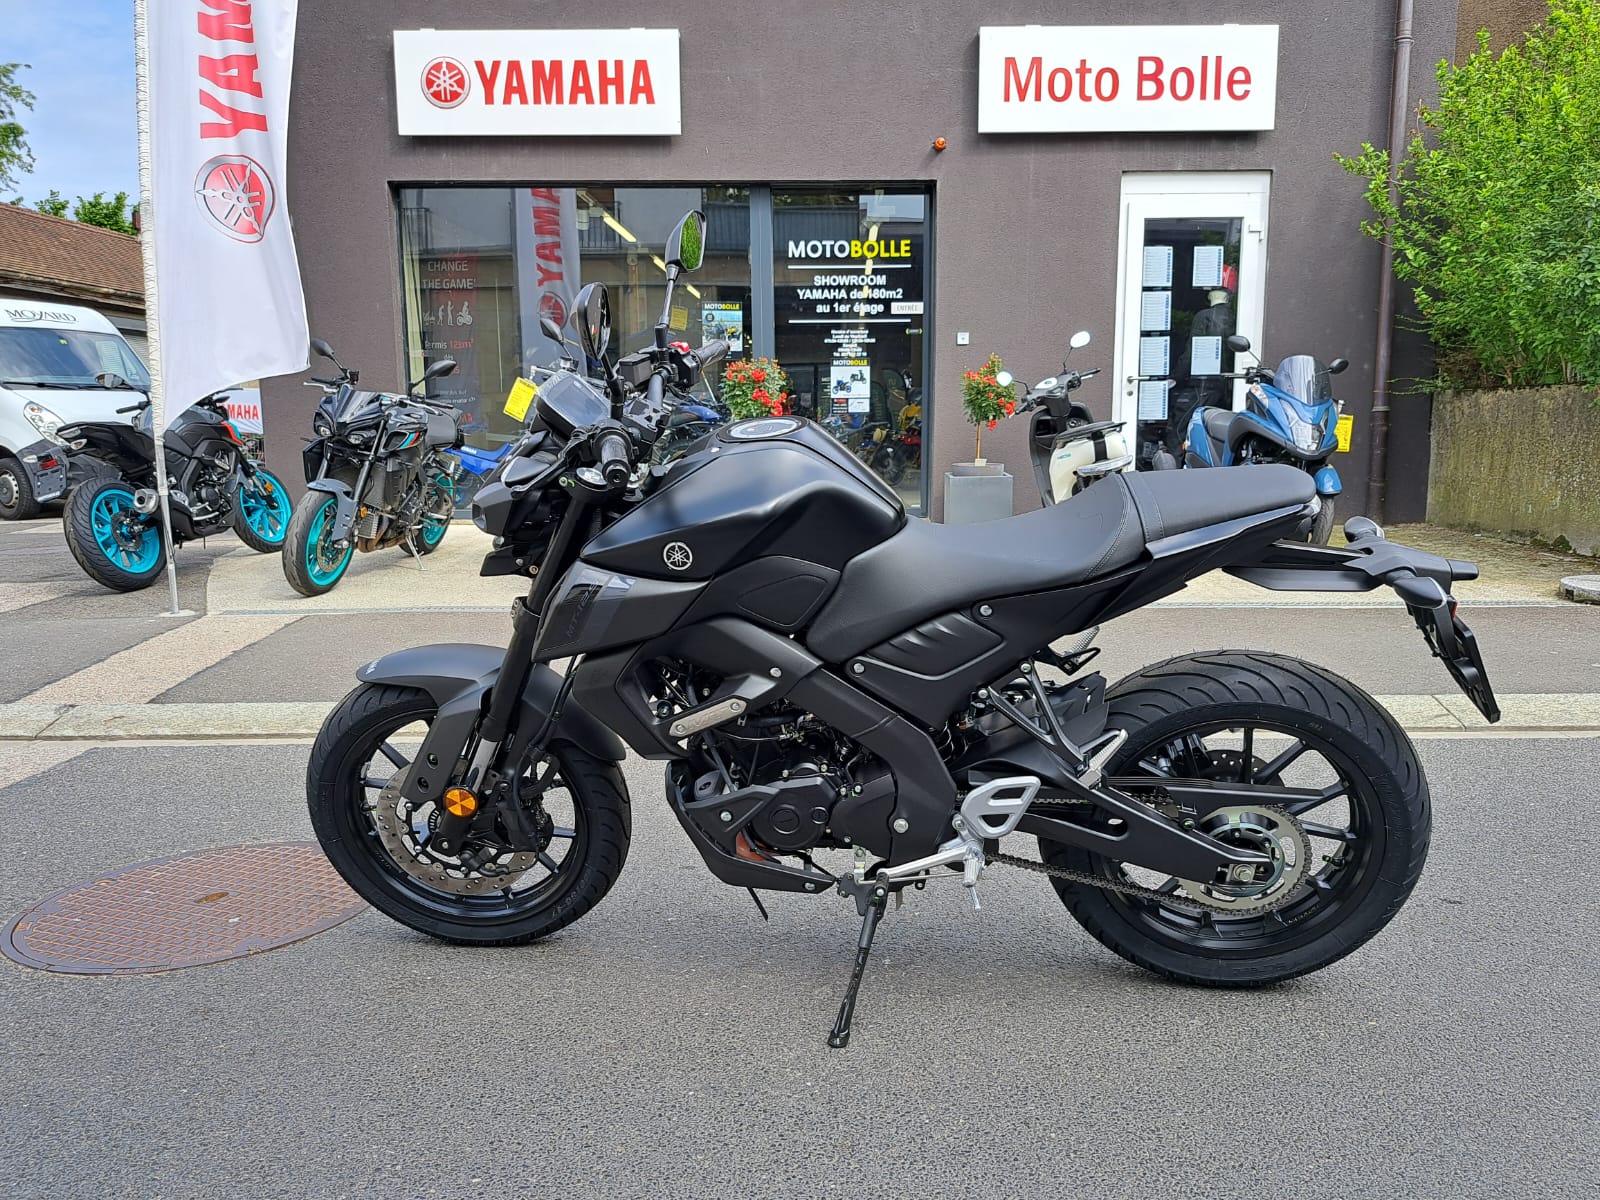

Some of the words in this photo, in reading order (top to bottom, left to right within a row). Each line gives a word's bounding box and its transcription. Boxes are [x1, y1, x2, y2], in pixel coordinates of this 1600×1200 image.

[474, 59, 656, 105] YAMAHA
[1003, 56, 1120, 102] Moto
[1136, 55, 1251, 101] Bolle
[788, 239, 911, 258] MOTOBOLLE
[427, 260, 469, 272] CHANGE
[422, 279, 441, 289] THE
[813, 275, 887, 286] SHOWROOM
[797, 288, 848, 300] YAMAHA
[849, 288, 865, 299] de
[867, 287, 904, 299] 180m2
[816, 304, 831, 313] au
[833, 303, 851, 313] 1er
[853, 302, 885, 315] étage
[227, 403, 260, 420] MAHA
